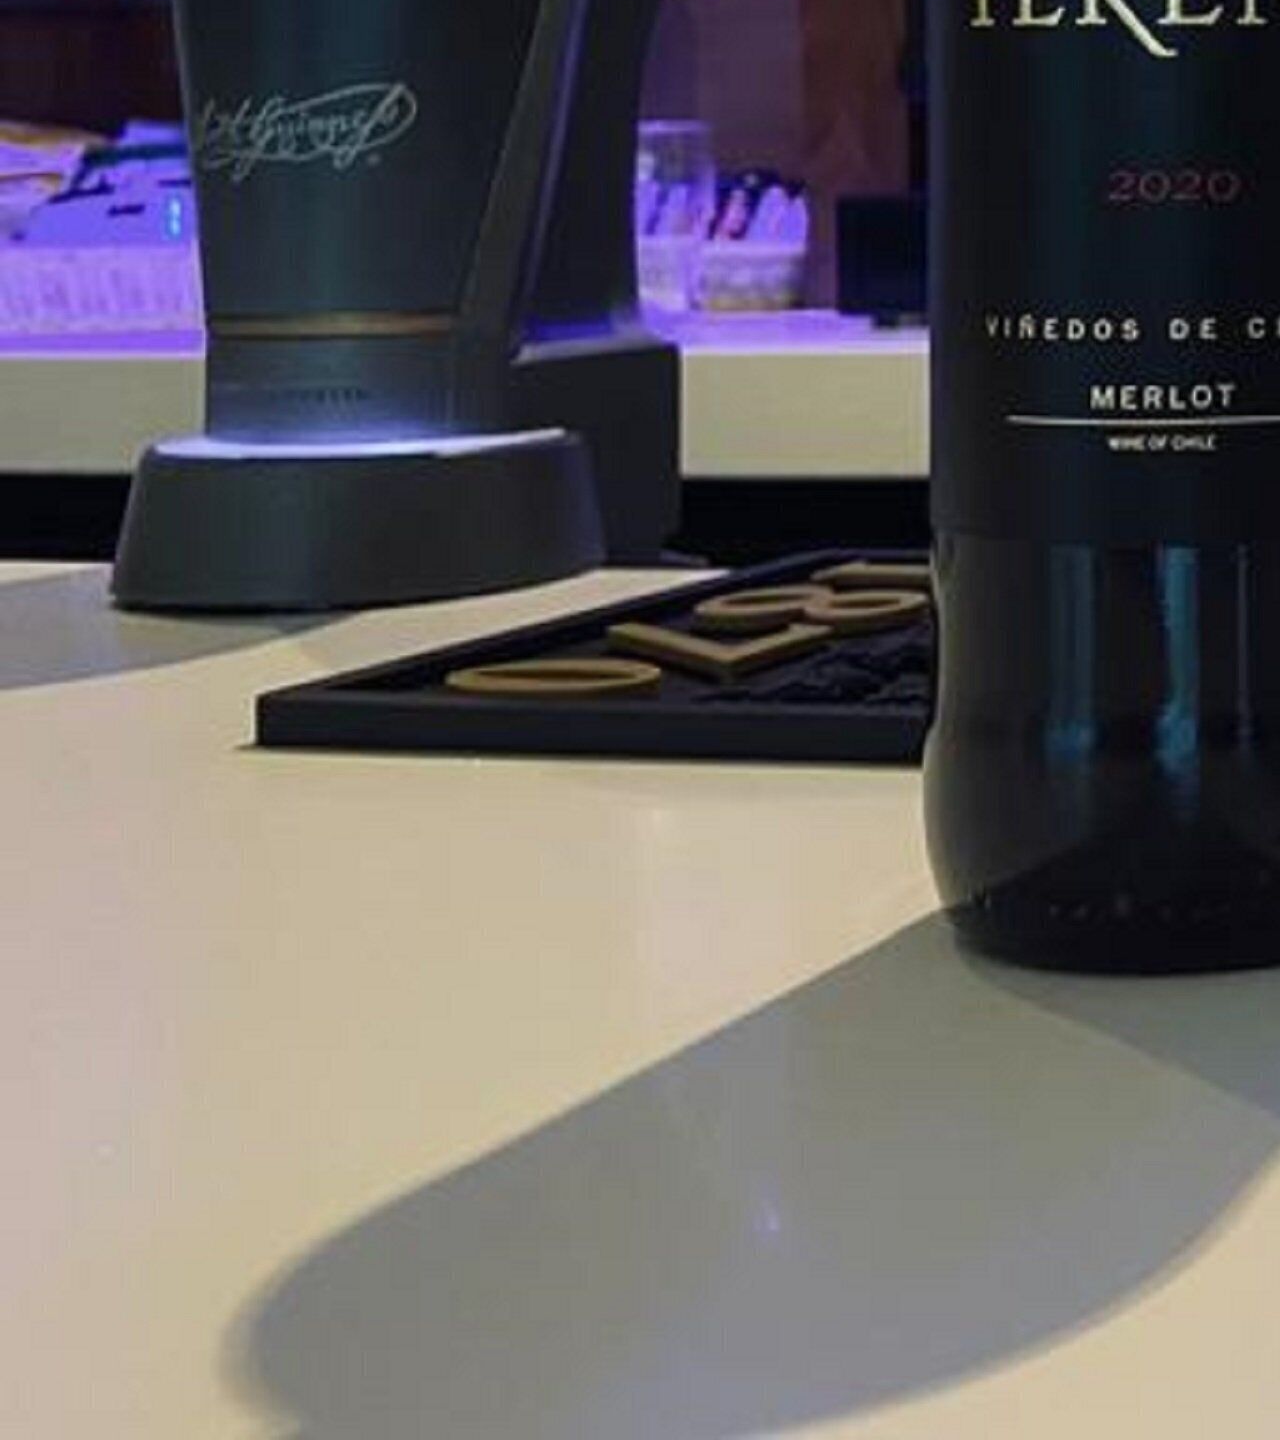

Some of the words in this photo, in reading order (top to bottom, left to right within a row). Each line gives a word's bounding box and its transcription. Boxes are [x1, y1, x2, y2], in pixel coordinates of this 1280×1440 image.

[1107, 169, 1242, 203] 2020
[985, 313, 1142, 341] VIÑEDOS
[1168, 317, 1219, 341] DE
[1089, 383, 1237, 411] MERLOT
[1108, 435, 1145, 452] WINE
[1147, 434, 1168, 452] OF
[1170, 433, 1217, 452] CHILE
